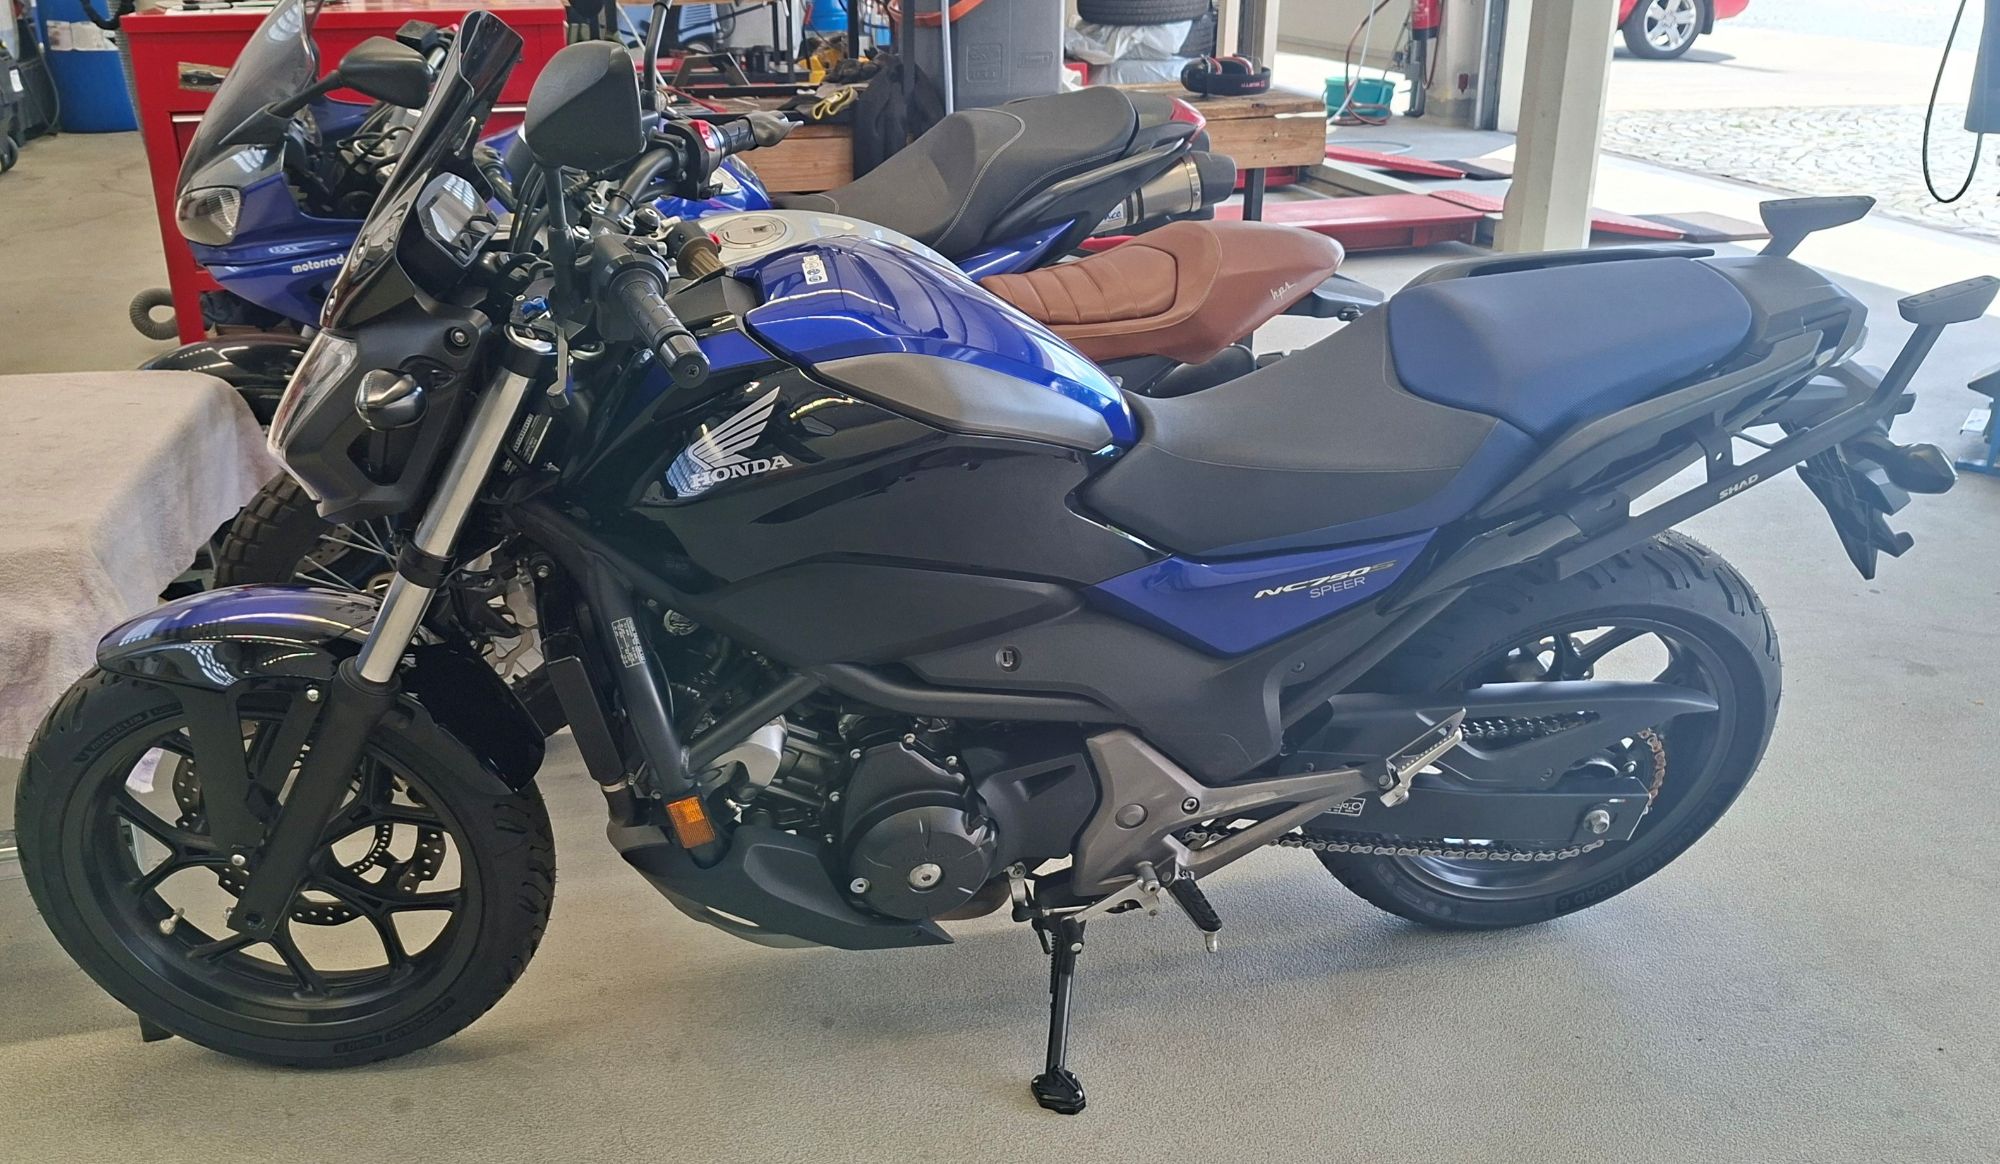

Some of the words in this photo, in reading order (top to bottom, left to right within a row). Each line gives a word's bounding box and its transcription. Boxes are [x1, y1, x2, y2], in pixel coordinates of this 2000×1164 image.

[291, 254, 344, 274] motorrad
[690, 455, 793, 488] HONDA
[1719, 474, 1759, 500] SHAD
[1254, 559, 1397, 599] NC750S
[1310, 576, 1366, 599] SPEER
[1574, 877, 1619, 904] ROAD
